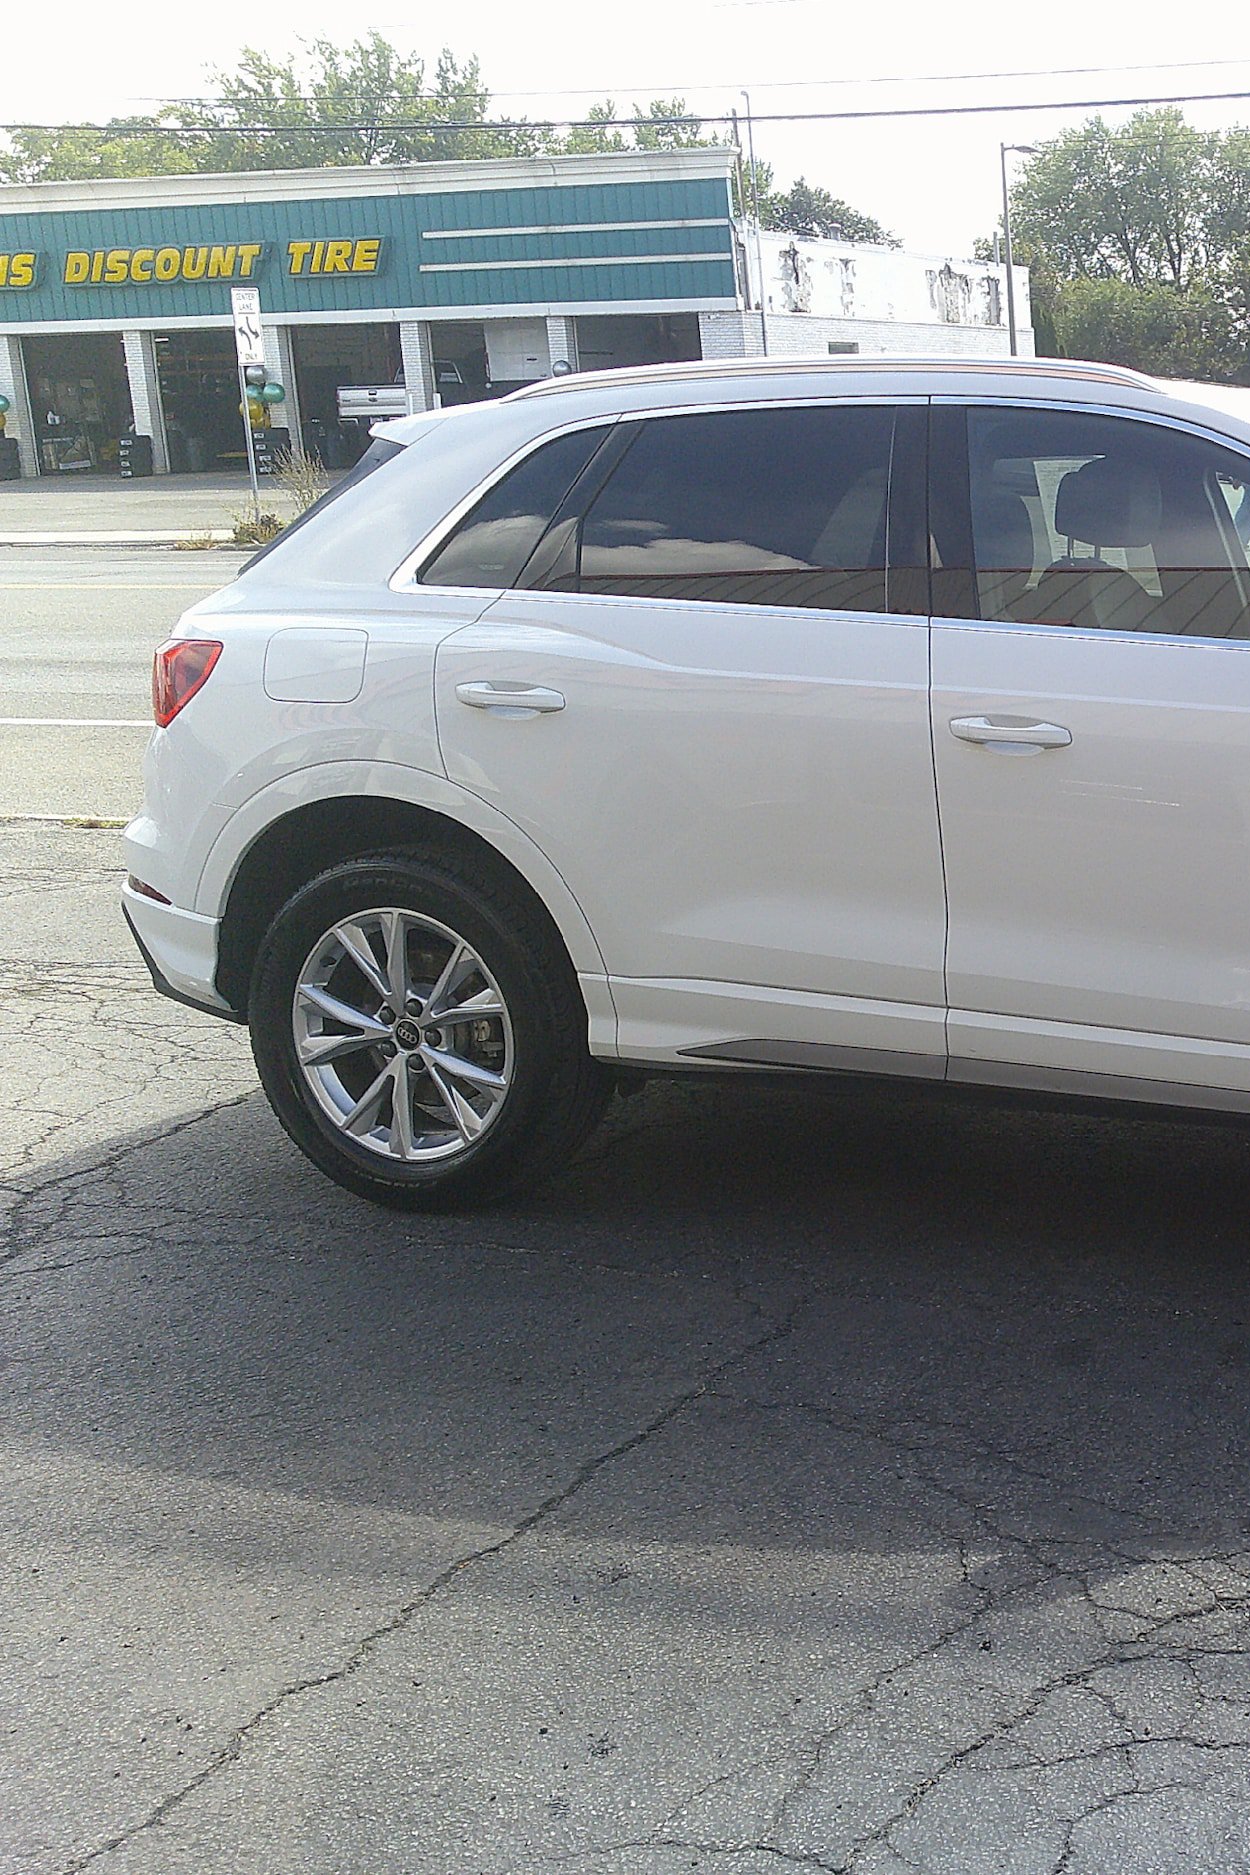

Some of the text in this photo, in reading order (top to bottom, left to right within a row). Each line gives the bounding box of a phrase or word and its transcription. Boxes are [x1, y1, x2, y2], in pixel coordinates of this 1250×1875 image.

[64, 244, 262, 284] DISCOUNT
[288, 238, 381, 275] TIRE
[239, 302, 253, 311] LANE
